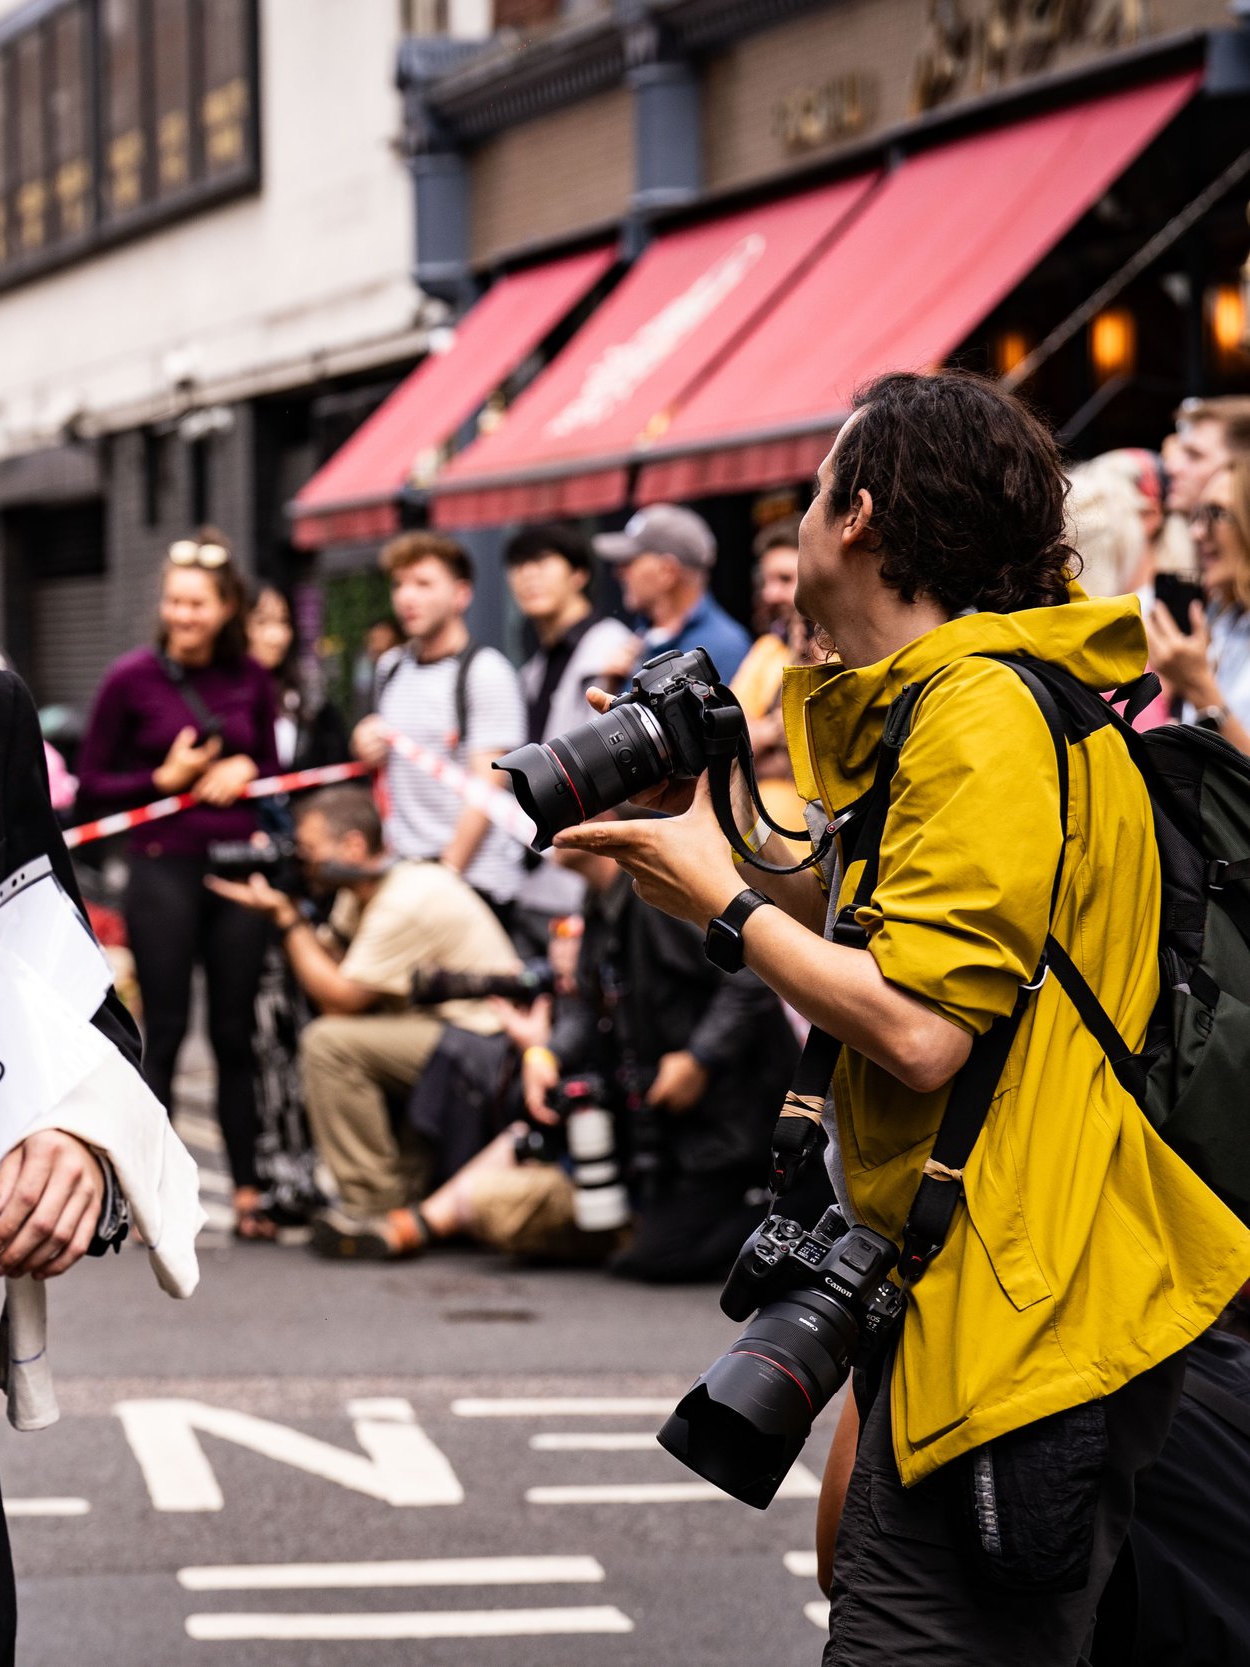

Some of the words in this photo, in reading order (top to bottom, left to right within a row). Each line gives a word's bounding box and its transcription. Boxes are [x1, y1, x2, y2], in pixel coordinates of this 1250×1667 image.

[825, 1277, 852, 1297] Canon
[798, 1317, 819, 1332] Canon
[866, 1313, 881, 1323] EOS
